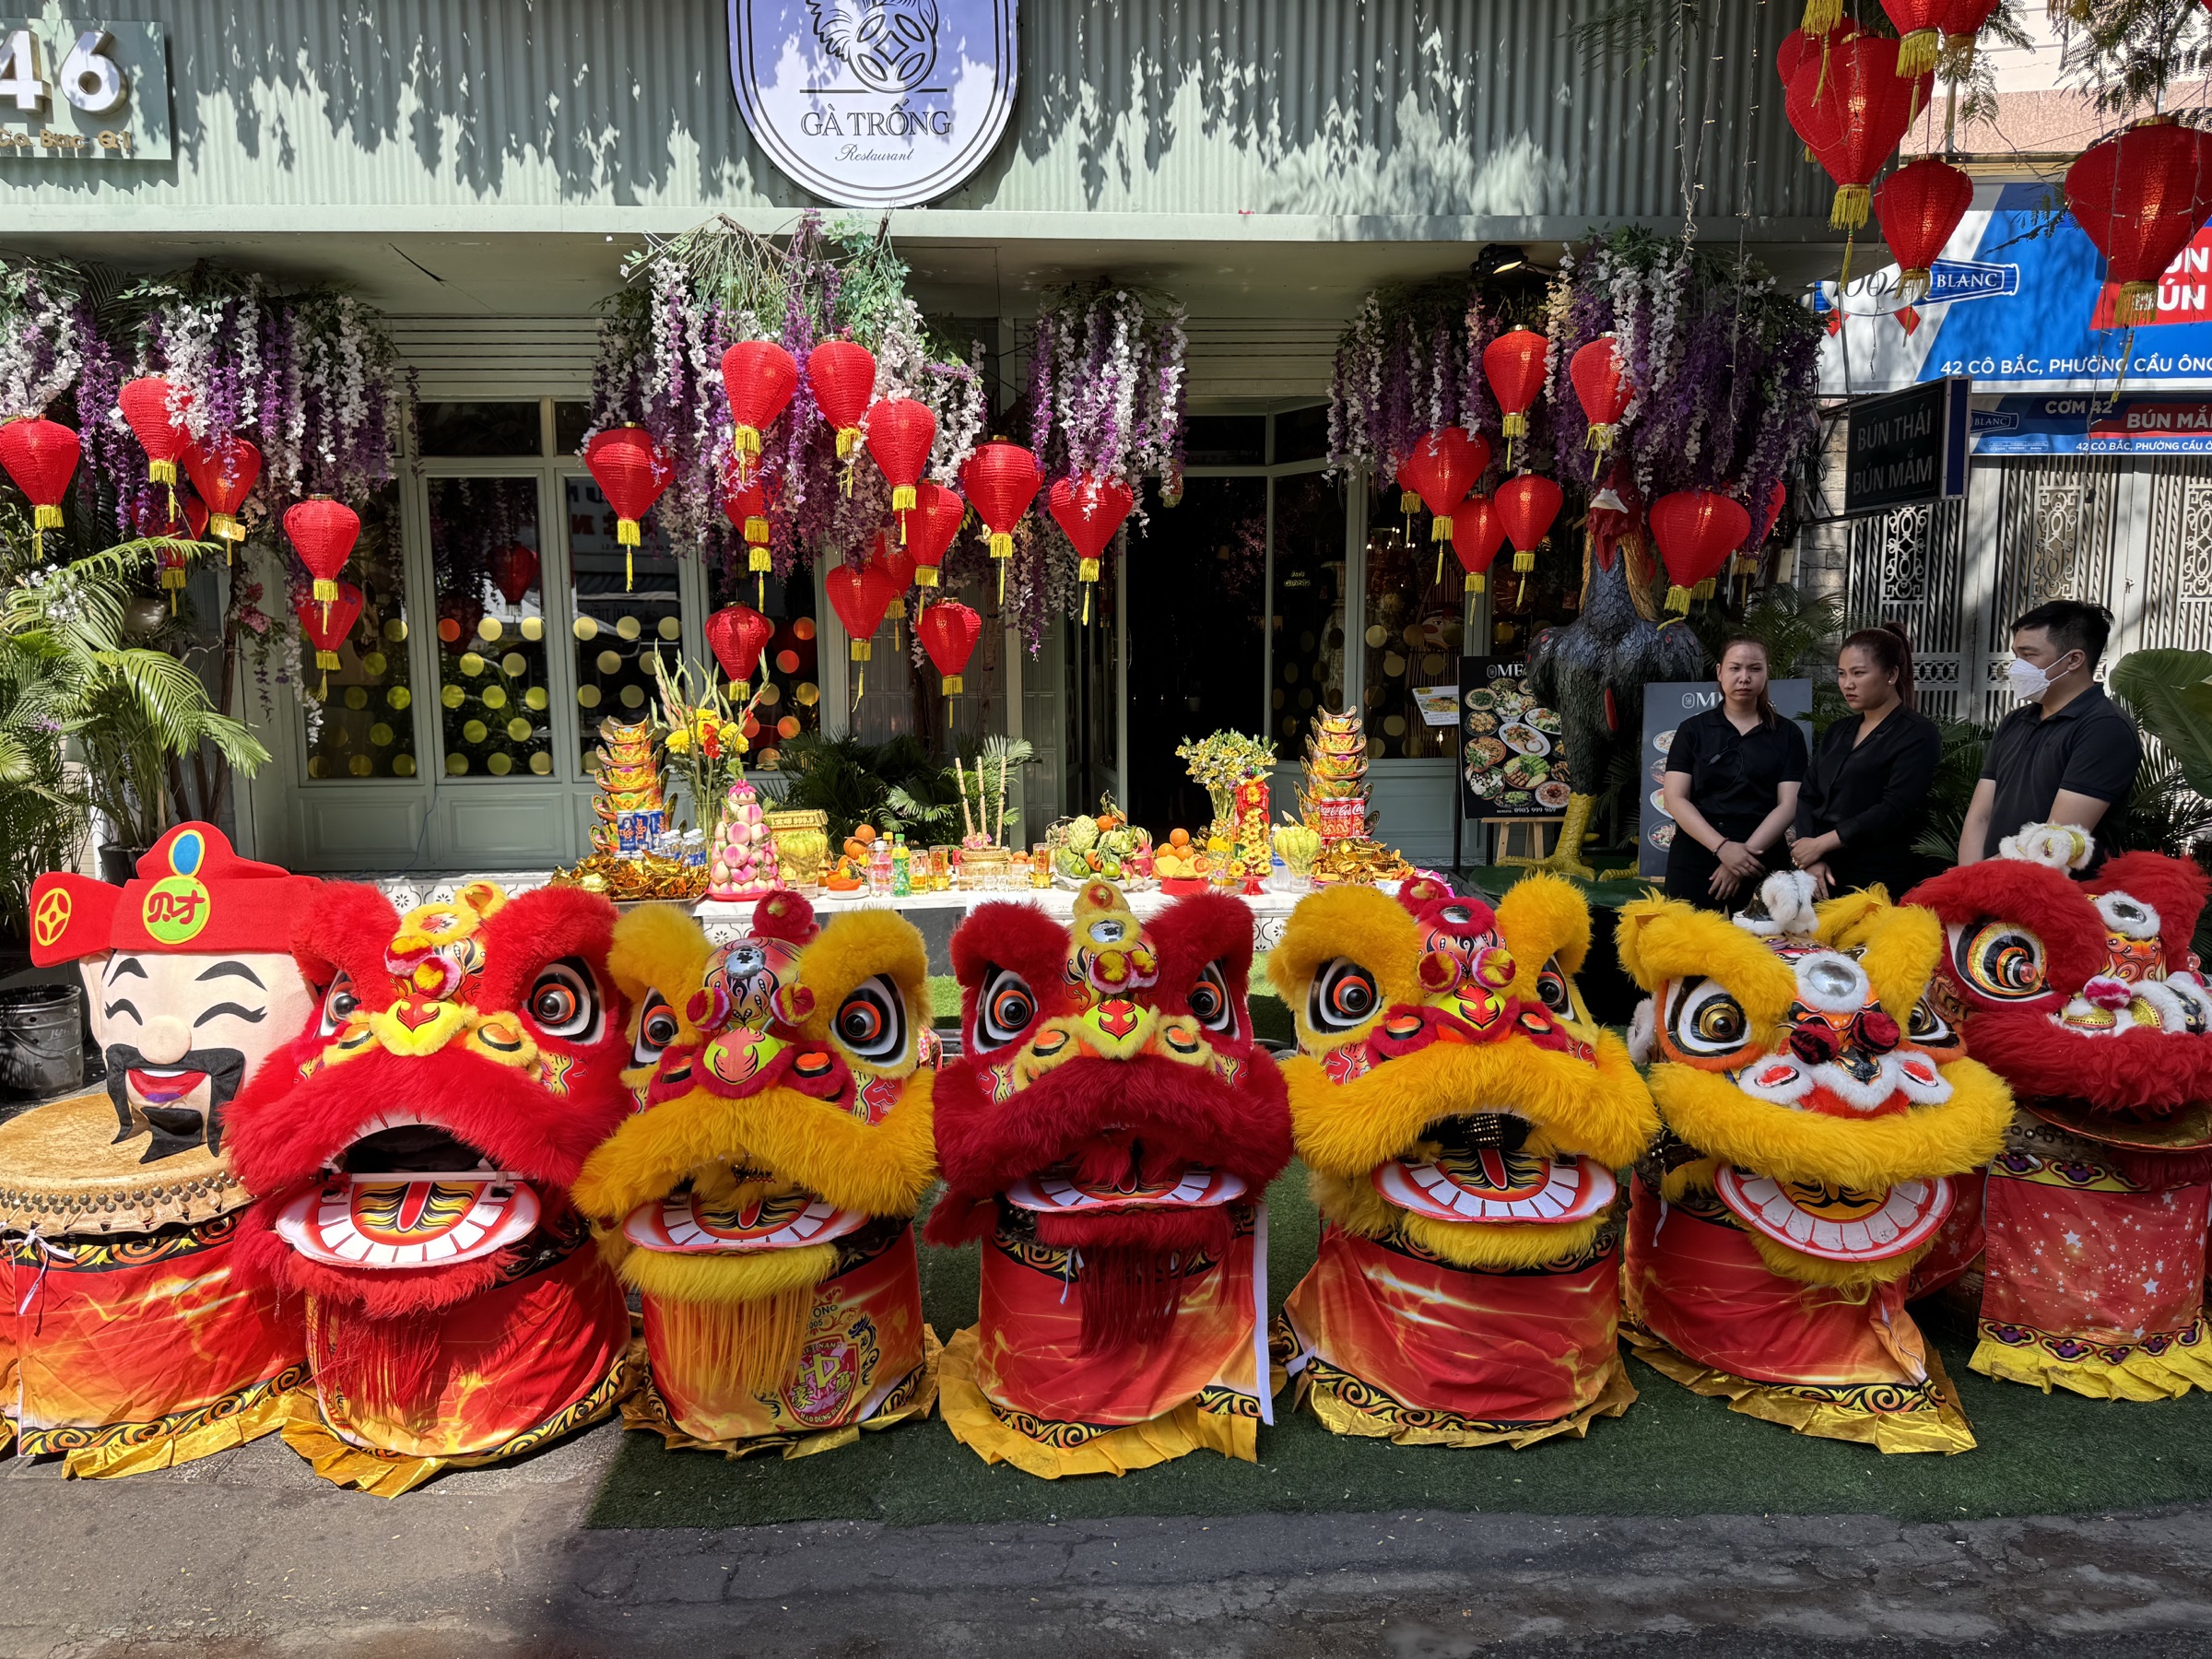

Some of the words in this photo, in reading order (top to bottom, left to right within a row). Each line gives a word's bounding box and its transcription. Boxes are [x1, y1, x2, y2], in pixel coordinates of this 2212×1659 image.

[0, 29, 124, 112] 46
[801, 103, 844, 135] GÀ
[847, 99, 951, 135] TRỐNG
[835, 143, 914, 161] Restaurant
[1936, 273, 1998, 288] BLANC
[1940, 360, 1962, 374] 42
[1968, 357, 1994, 374] CÔ
[2000, 354, 2043, 375] BẮC,
[2049, 355, 2127, 373] PHƯỜNG
[2134, 352, 2172, 372] CẦU
[2045, 400, 2086, 414] CƠM
[2091, 401, 2112, 414] 42
[2127, 408, 2171, 429] BÚN
[2177, 405, 2212, 429] MẮ
[1857, 417, 1889, 452] BÚN
[1894, 403, 1931, 441] THÁI
[1974, 418, 2007, 427] BLANC
[2076, 442, 2088, 451] 42
[2091, 441, 2106, 451] CÔ
[2136, 440, 2180, 451] PHƯỜNG
[1853, 463, 1884, 496] BÚN
[1888, 448, 1933, 489] MẮM
[806, 1319, 823, 1329] 005
